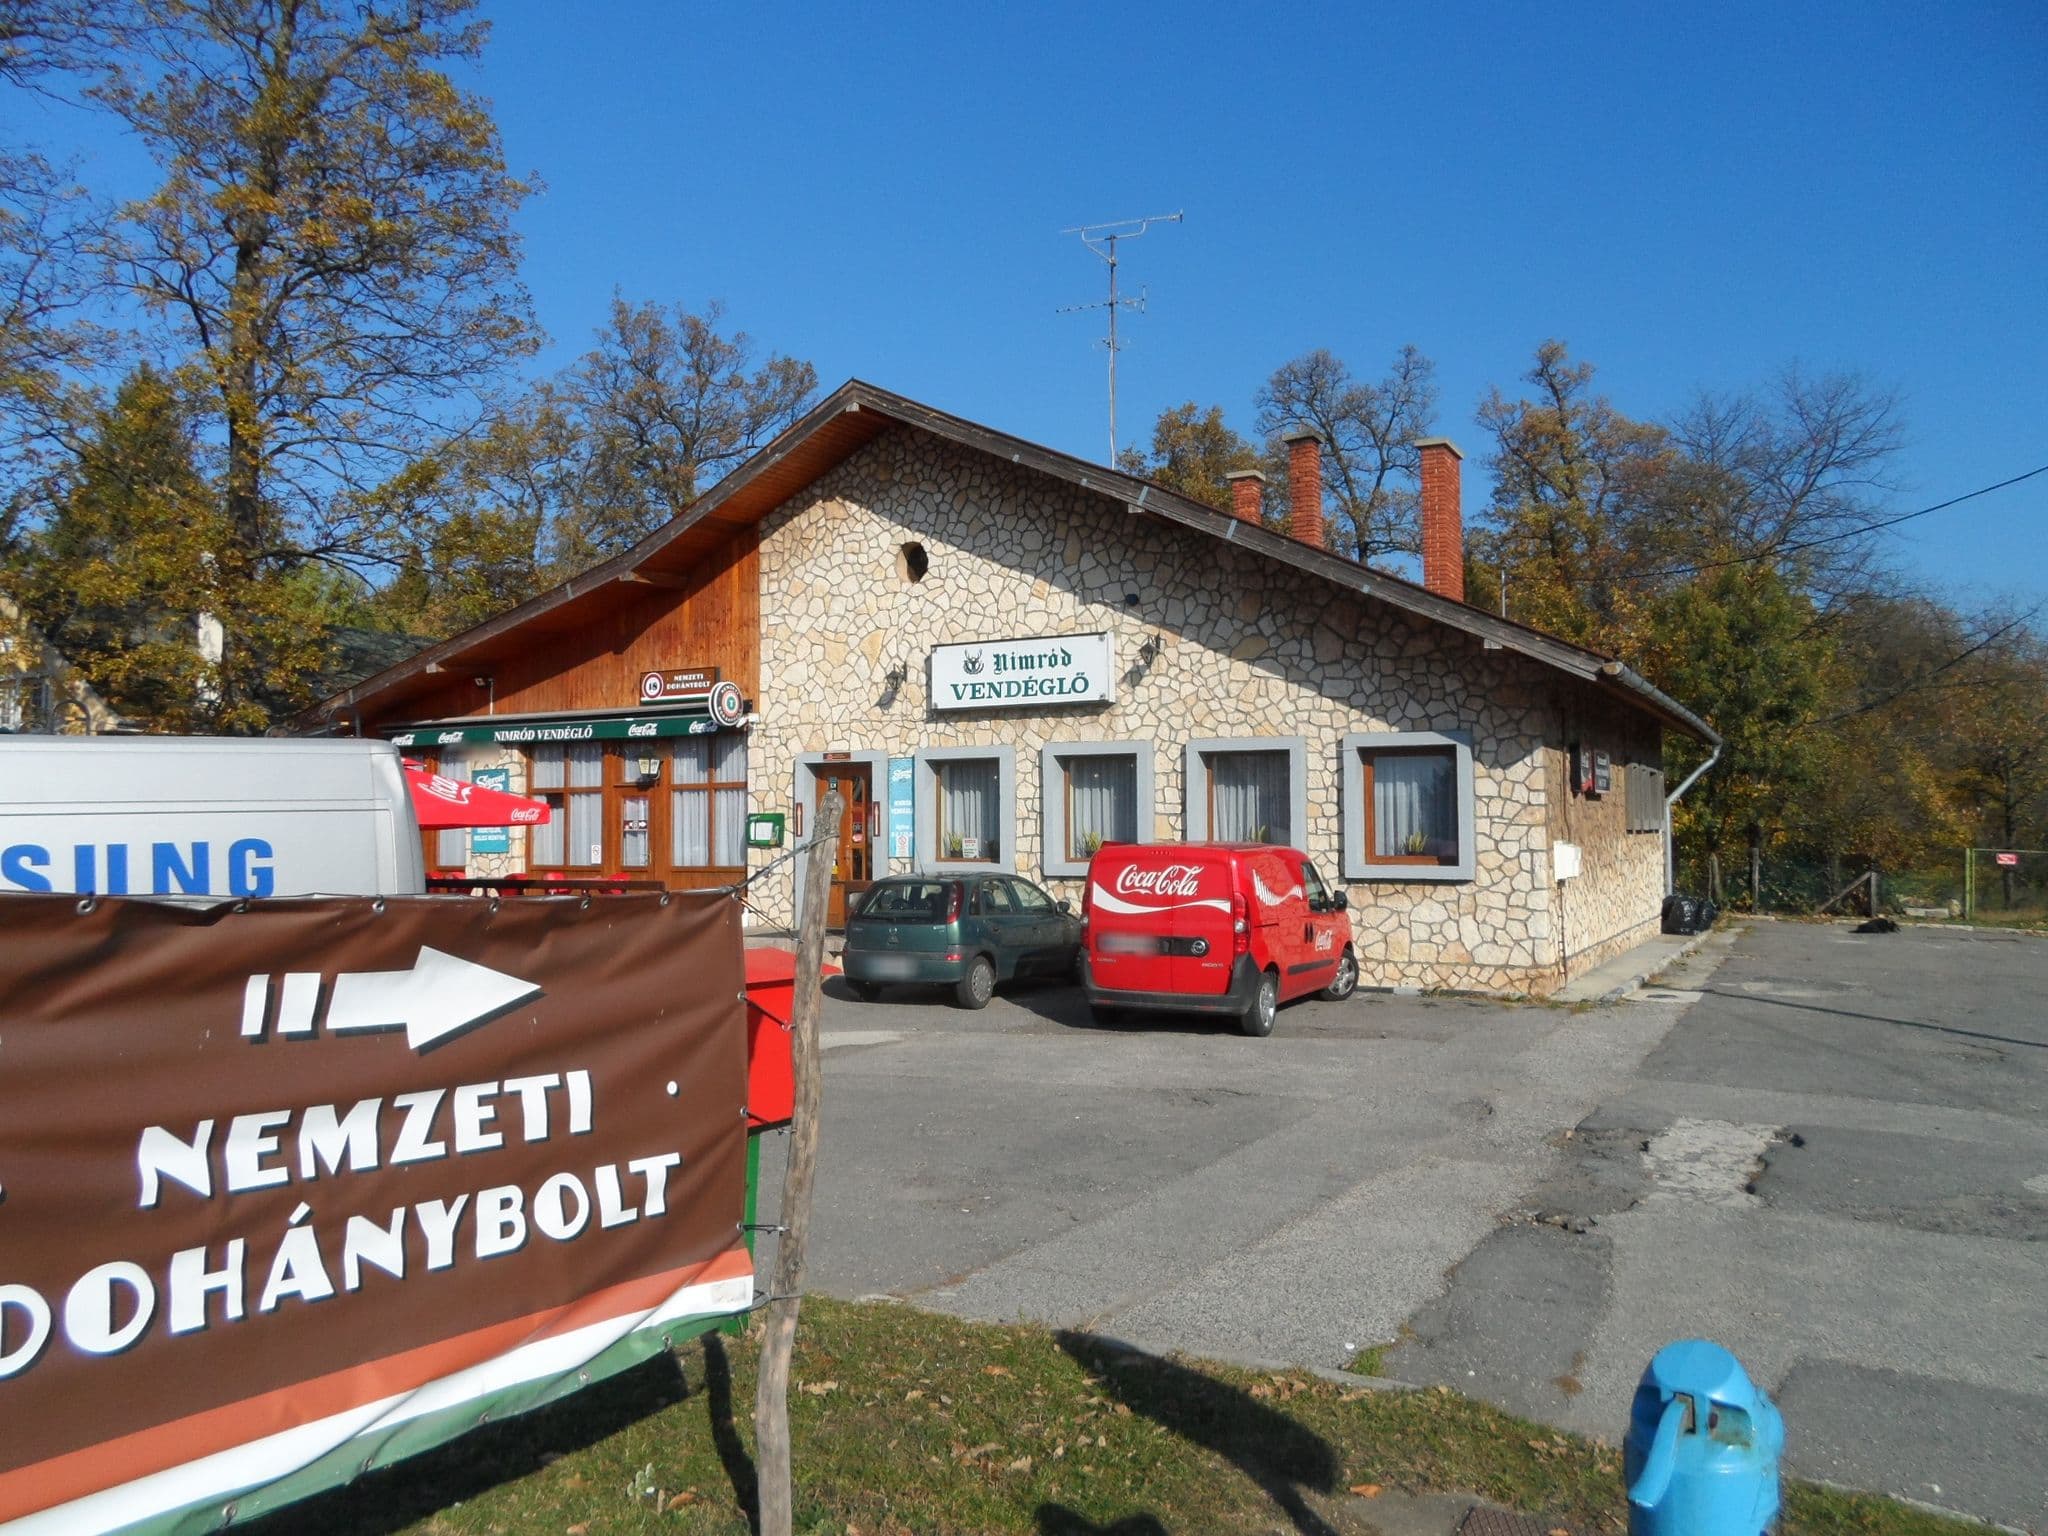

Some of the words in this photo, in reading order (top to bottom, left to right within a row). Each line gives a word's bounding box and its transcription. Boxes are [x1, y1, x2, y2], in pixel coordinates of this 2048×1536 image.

[992, 647, 1073, 675] Nimród
[673, 673, 704, 681] NEMZETI
[648, 682, 658, 691] 18
[950, 672, 1090, 701] VENDÉGLŐ
[494, 727, 535, 742] NIMRÓD
[537, 724, 594, 740] VENDÉGLŐ
[628, 722, 658, 736] Coca-Cola
[437, 731, 465, 745] Coca-Cola
[511, 808, 541, 822] Coca-Cola
[1116, 864, 1205, 896] Coca-Cola
[138, 1069, 594, 1209] NEMZETI
